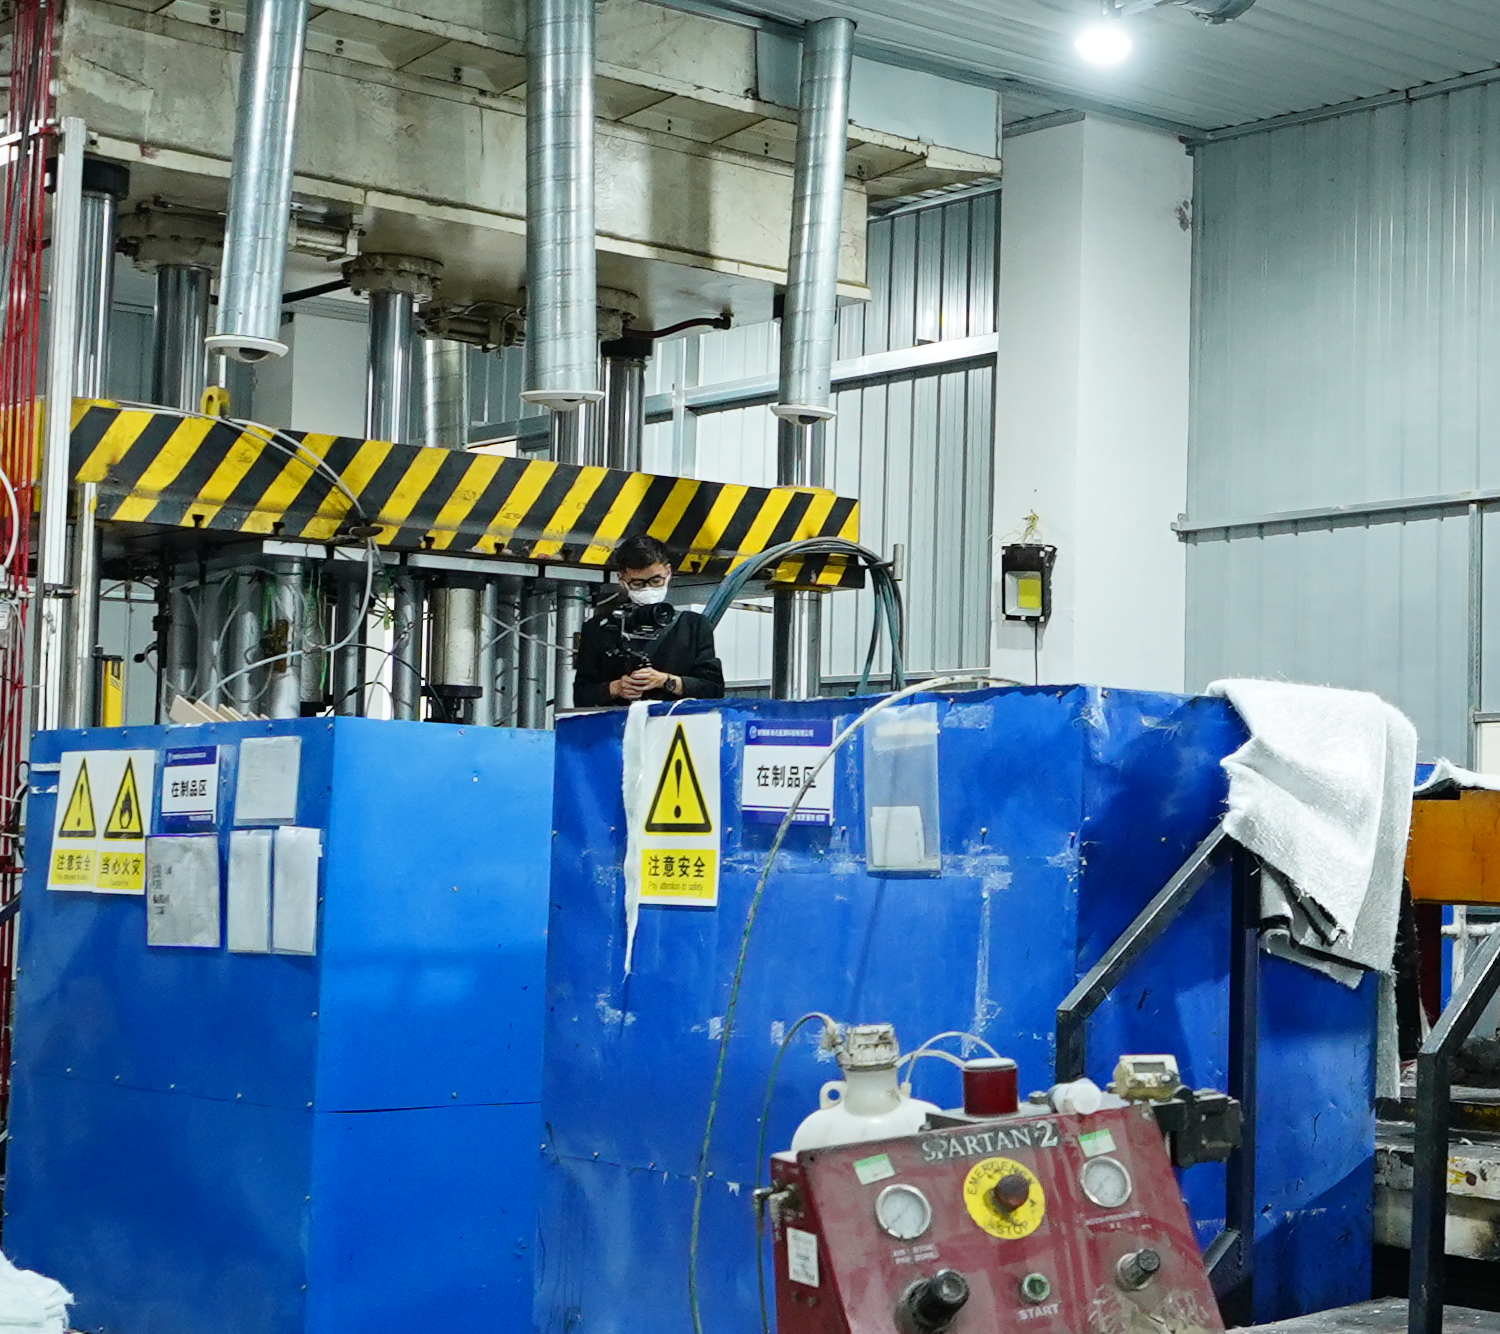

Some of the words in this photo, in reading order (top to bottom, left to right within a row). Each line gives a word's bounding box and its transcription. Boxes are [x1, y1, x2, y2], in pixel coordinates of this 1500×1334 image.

[756, 765, 817, 788] 在制品区
[171, 779, 208, 798] 在制品区
[57, 854, 92, 871] 注意安全
[101, 857, 141, 875] 当心火灾
[648, 855, 706, 878] 注意安全
[921, 1126, 1032, 1162] SPARTAN
[1017, 1301, 1060, 1321] START
